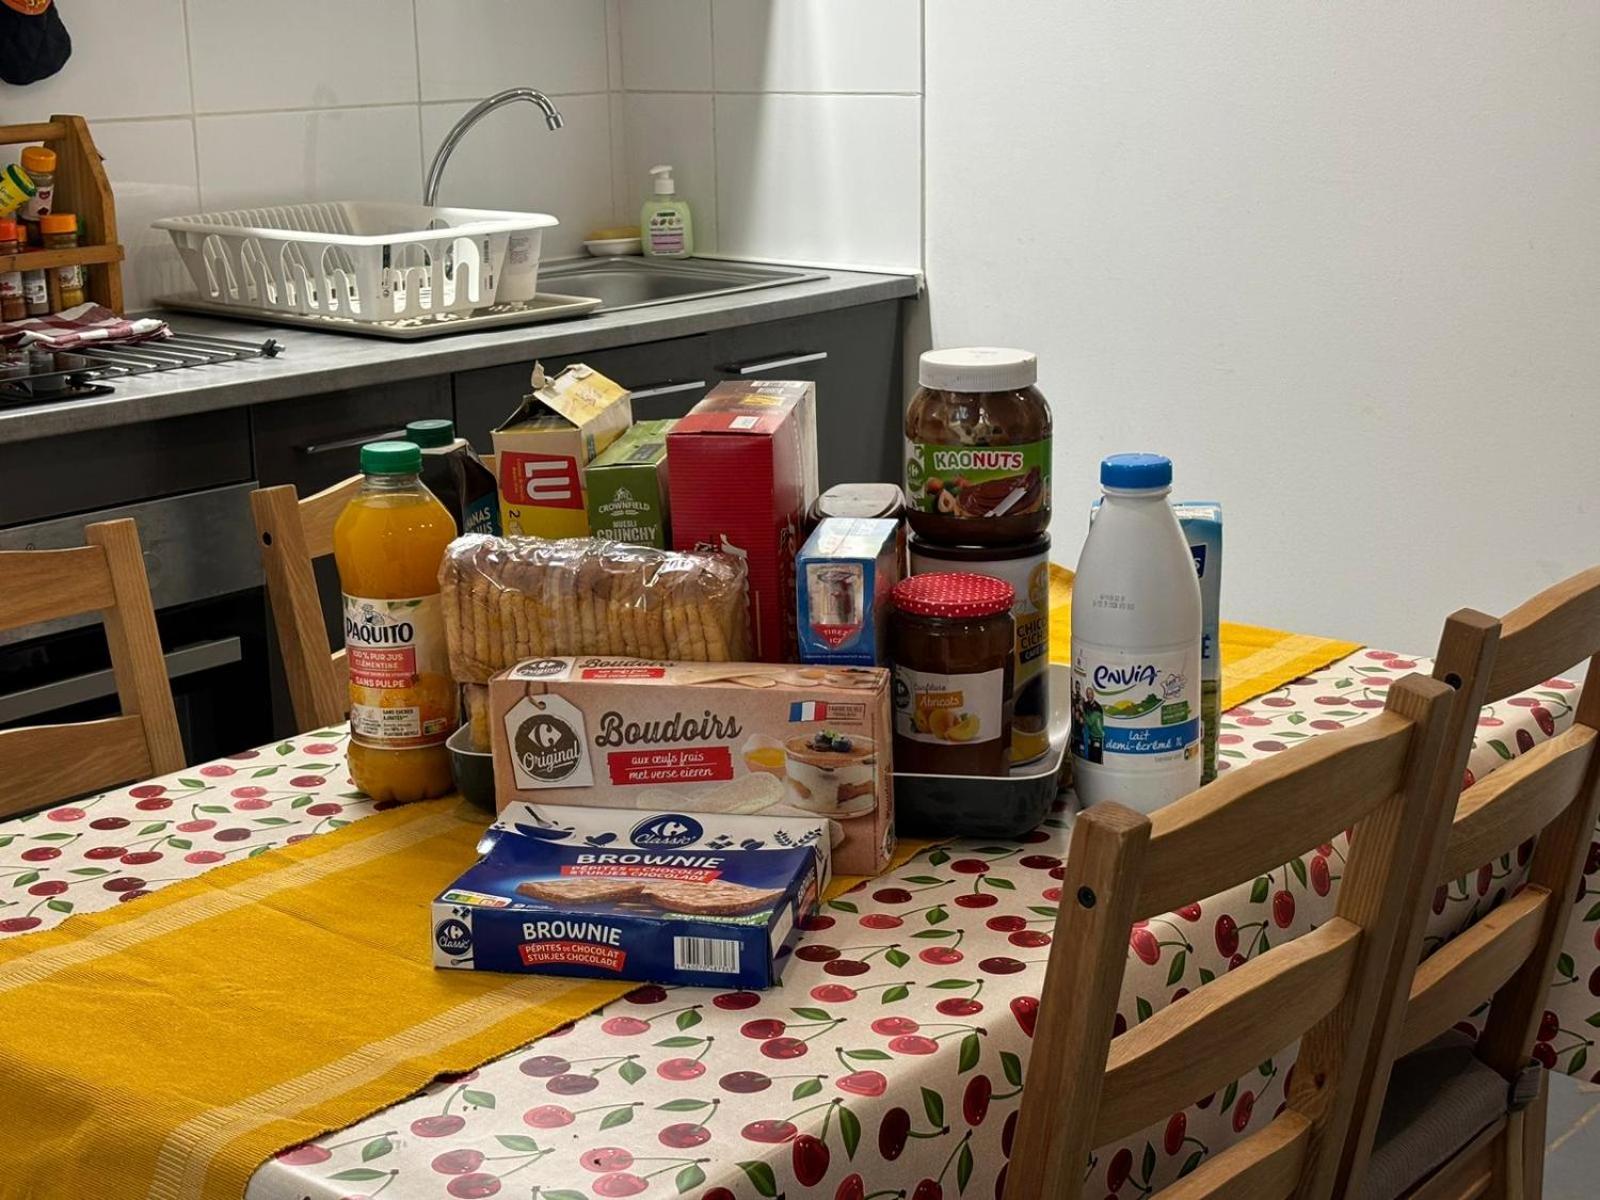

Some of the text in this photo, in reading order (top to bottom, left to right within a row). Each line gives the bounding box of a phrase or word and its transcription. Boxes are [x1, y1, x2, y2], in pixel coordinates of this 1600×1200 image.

[934, 452, 1023, 470] KAONUTS
[525, 461, 571, 500] LU
[598, 501, 650, 513] CROWNFIELD
[596, 527, 656, 541] CRUNCHY
[346, 617, 414, 644] PAQUITO
[375, 679, 405, 688] PULPE
[595, 710, 742, 747] Boudoirs
[522, 740, 580, 774] Original
[631, 756, 650, 765] aux
[680, 751, 705, 767] frais
[628, 767, 714, 780] met verse eieren
[633, 833, 693, 845] Classic
[576, 854, 726, 869] BROWNIE
[640, 867, 712, 876] CHOCOLAT
[522, 921, 623, 946] BROWNIE
[525, 943, 562, 954] PÉPITES
[571, 943, 619, 960] CHOCOLAT
[527, 952, 619, 968] STUKJES CHOCOLADE
